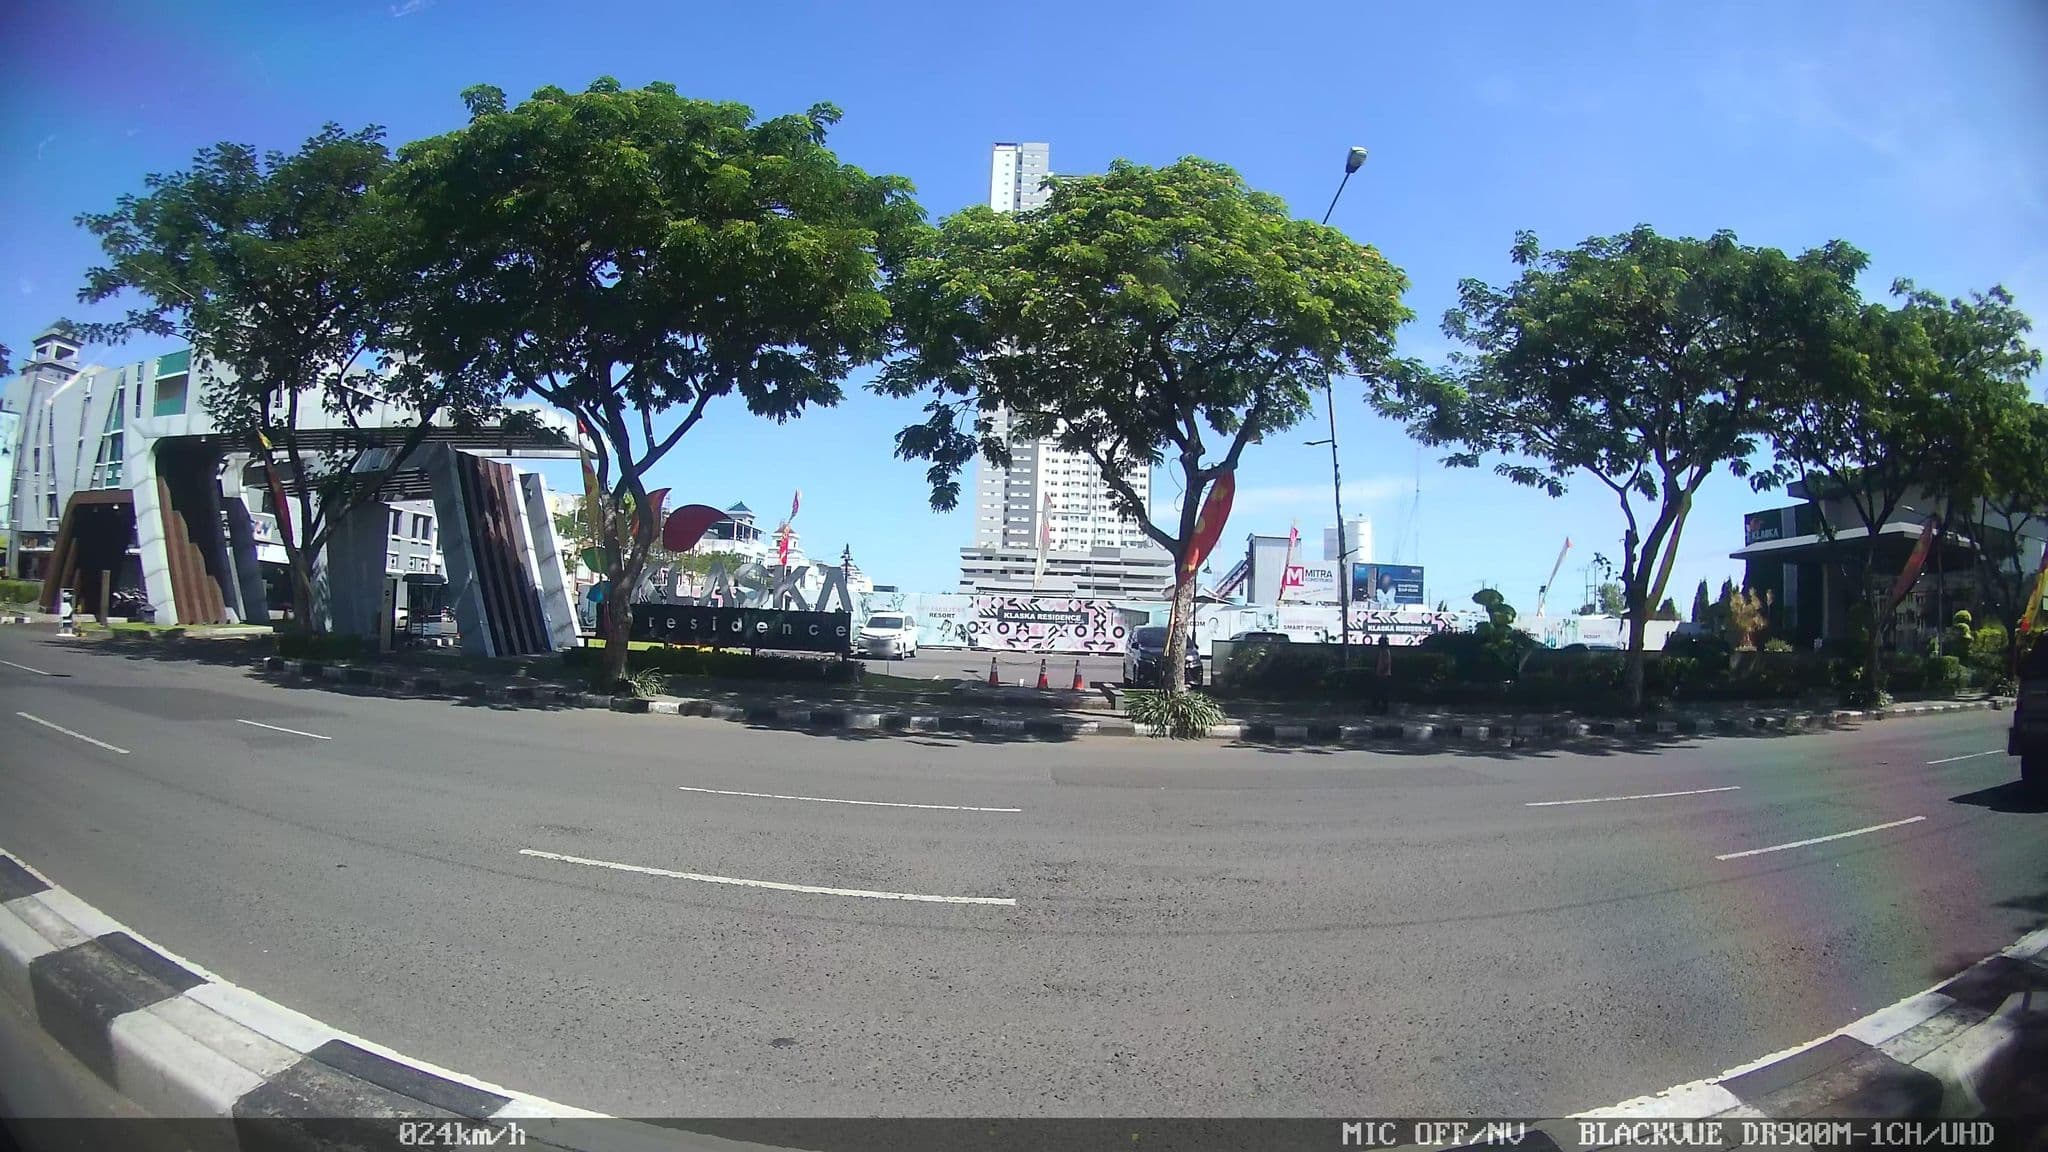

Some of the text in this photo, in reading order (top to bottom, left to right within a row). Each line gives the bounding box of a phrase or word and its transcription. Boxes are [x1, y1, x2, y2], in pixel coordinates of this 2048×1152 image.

[1305, 569, 1333, 578] MITRA
[1003, 612, 1036, 620] KLASKA
[1037, 613, 1082, 623] RESIDENCE
[648, 615, 847, 636] residence
